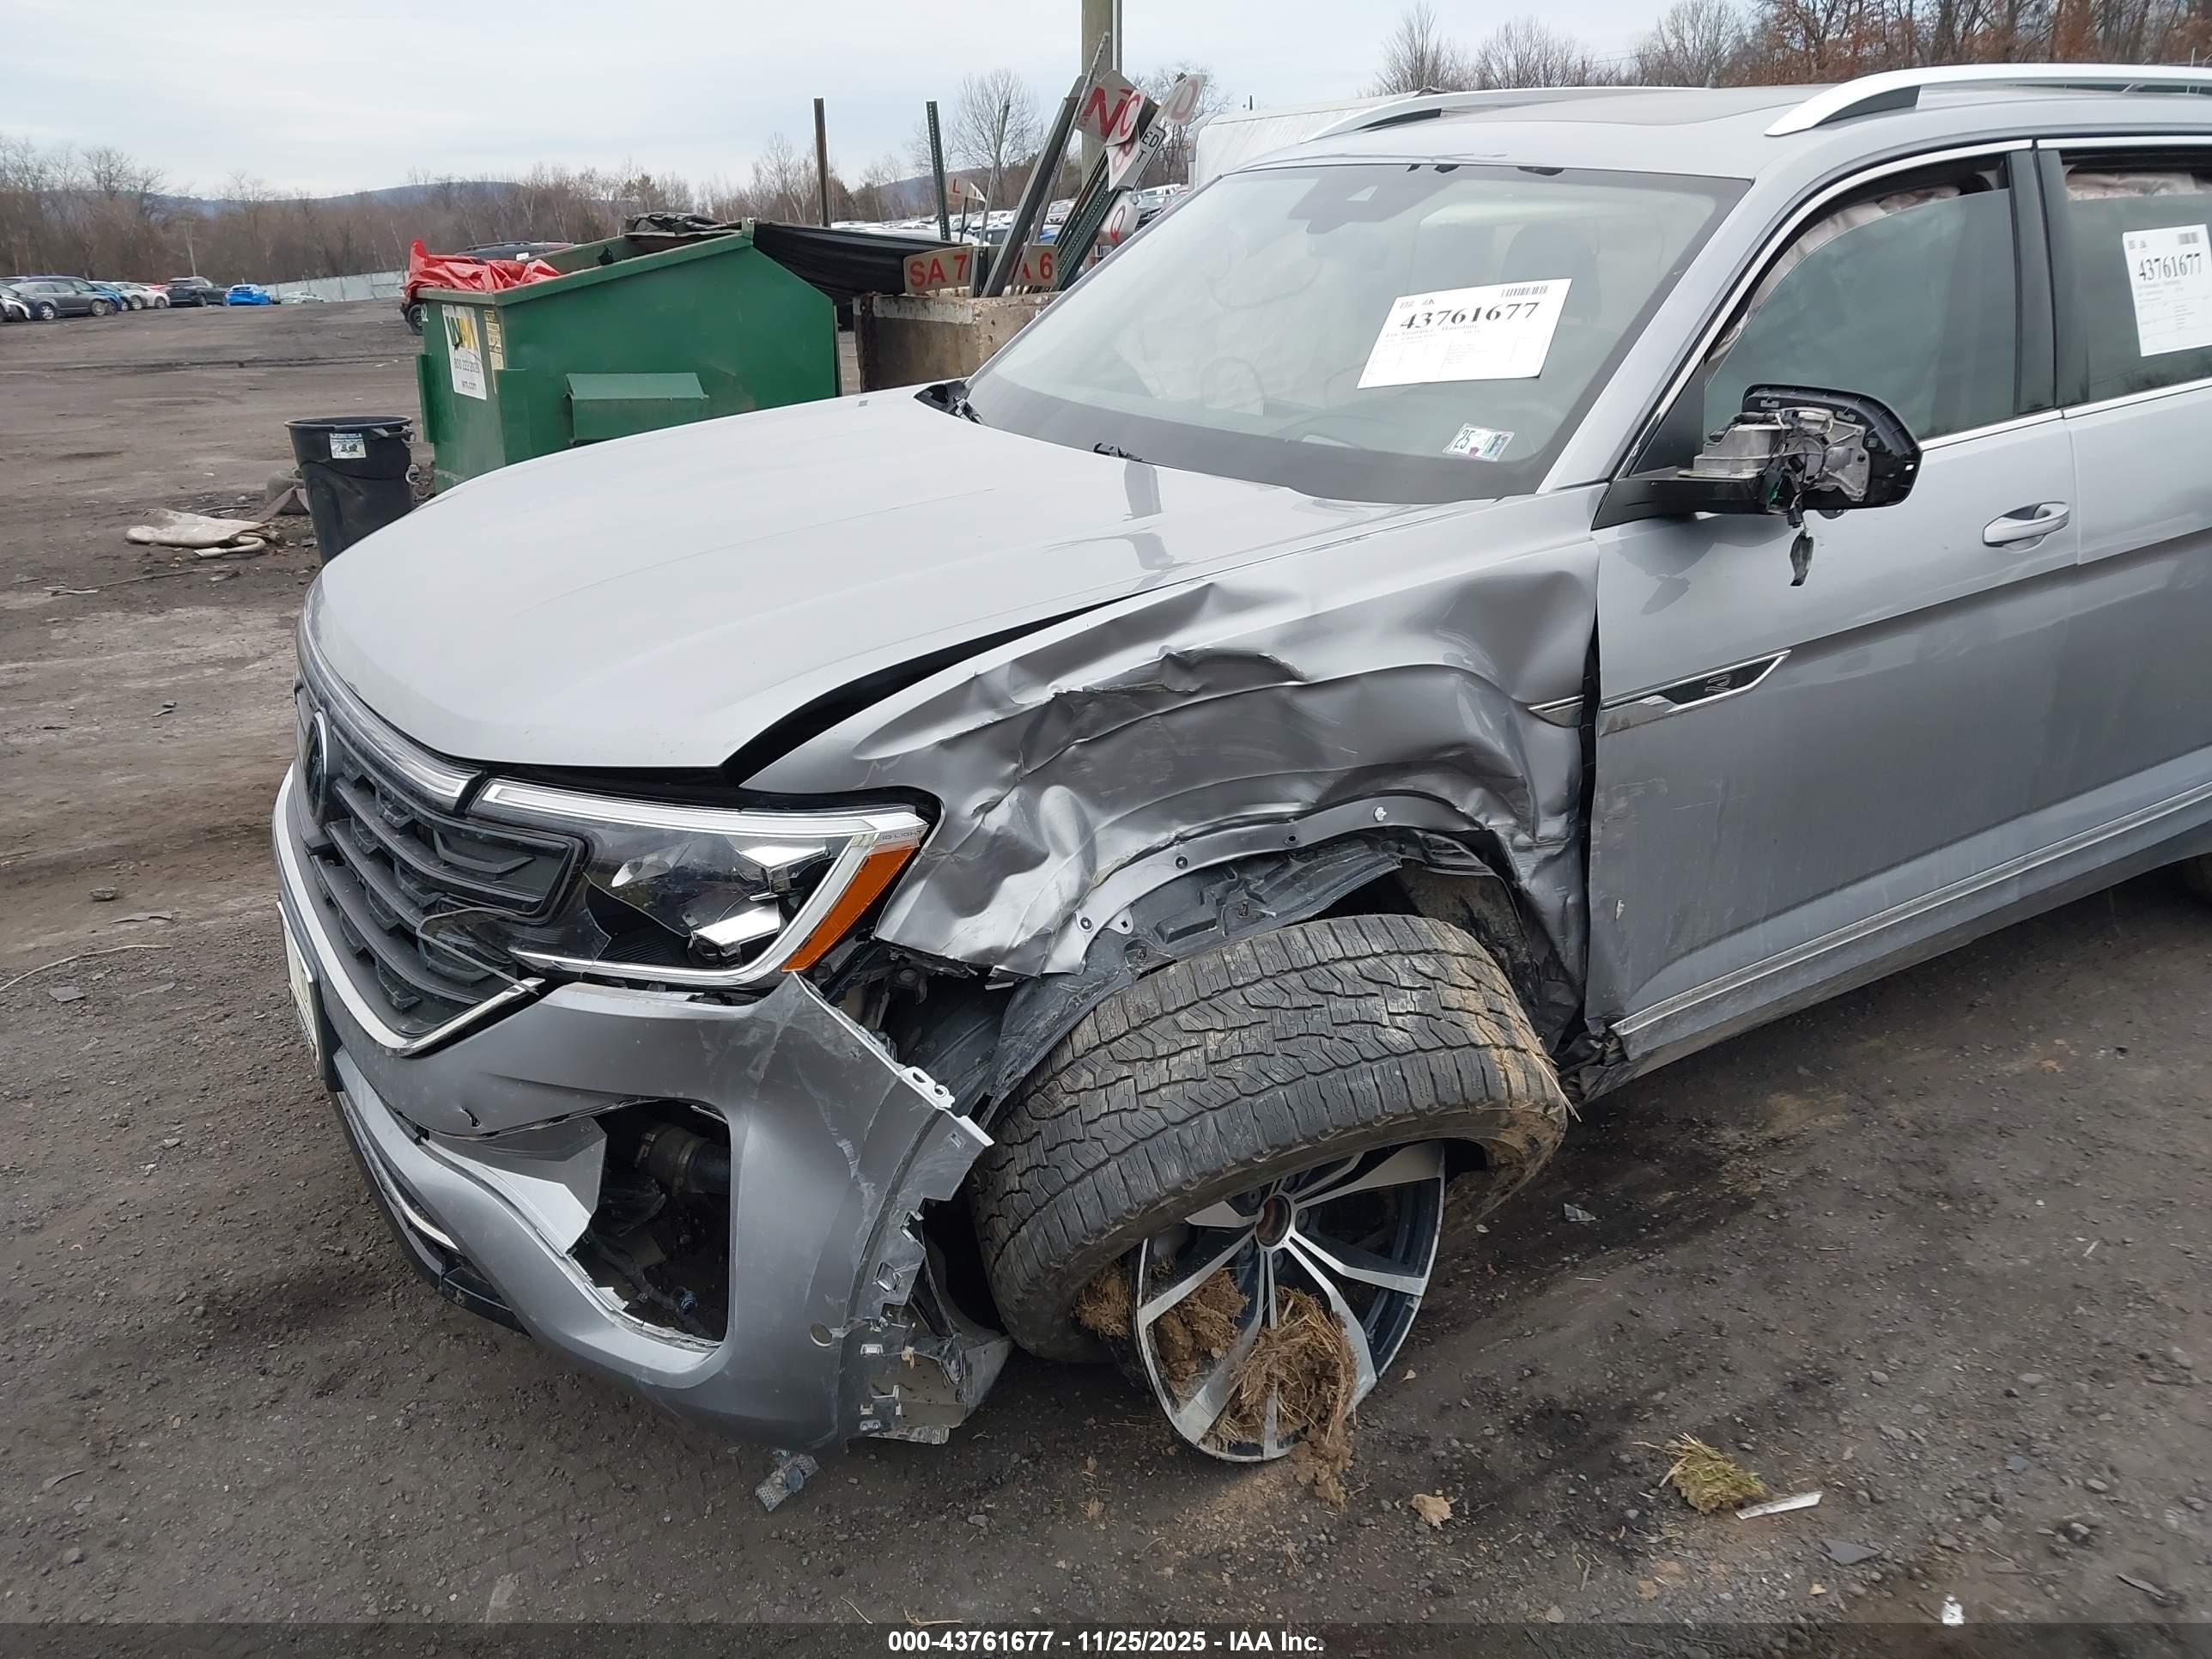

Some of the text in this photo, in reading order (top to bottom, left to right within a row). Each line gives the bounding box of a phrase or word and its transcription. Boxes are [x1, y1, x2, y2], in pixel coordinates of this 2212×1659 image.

[951, 178, 961, 194] L
[908, 254, 968, 288] SA 7
[1038, 252, 1054, 280] 6
[2137, 252, 2201, 282] 43761677
[1400, 301, 1540, 330] 43761677
[1453, 429, 1476, 450] 25
